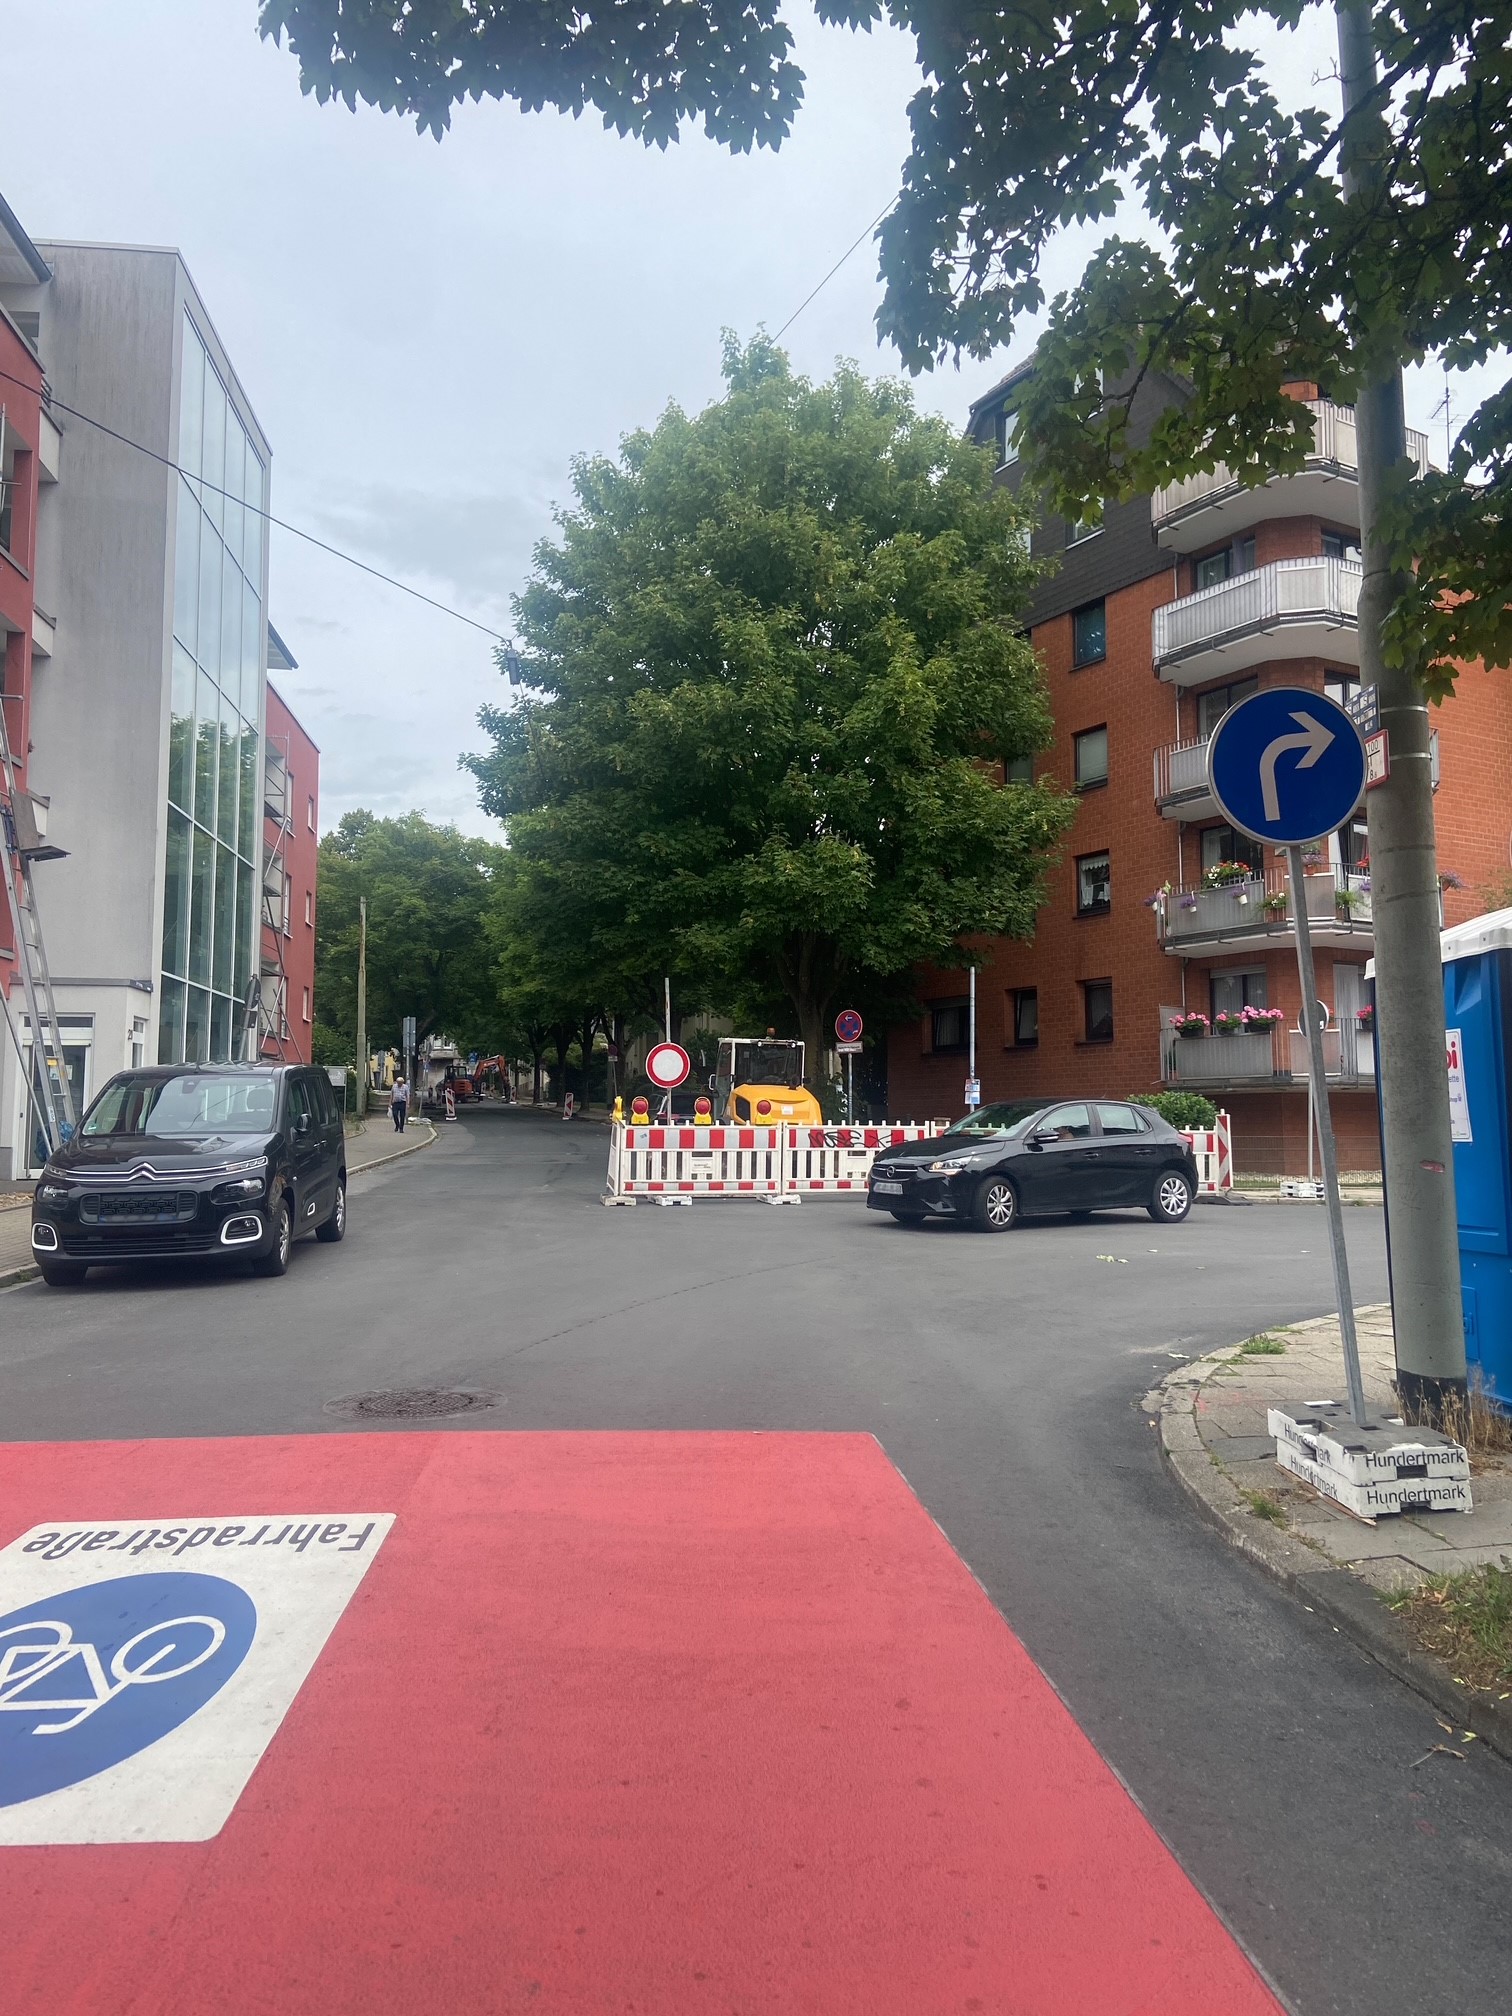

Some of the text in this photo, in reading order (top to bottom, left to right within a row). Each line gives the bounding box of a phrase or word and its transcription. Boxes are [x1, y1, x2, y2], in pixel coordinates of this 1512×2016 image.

[1365, 1449, 1465, 1468] Hundertmark
[1366, 1484, 1466, 1505] Hundertmark
[22, 1522, 377, 1561] Fahrradstraße
